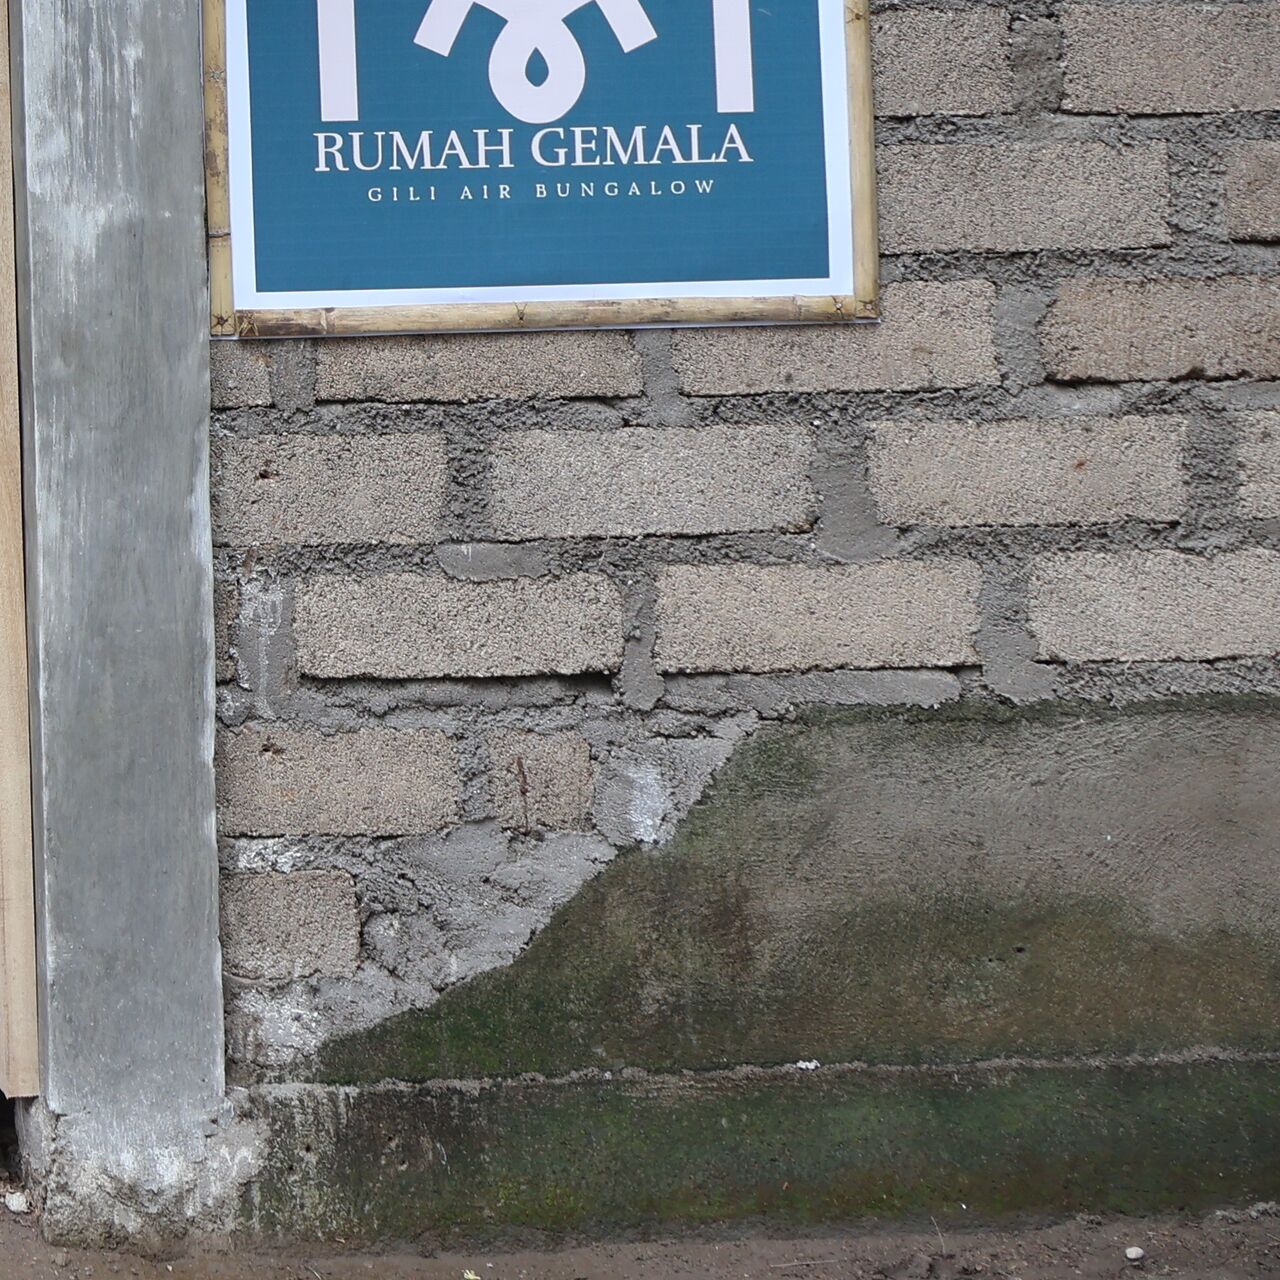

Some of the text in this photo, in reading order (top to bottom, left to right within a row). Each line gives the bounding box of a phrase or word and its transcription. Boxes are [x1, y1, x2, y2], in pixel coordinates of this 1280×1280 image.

[313, 123, 754, 172] RUMAH GEMALA
[367, 179, 714, 202] GILI AIR BUNGALOW
